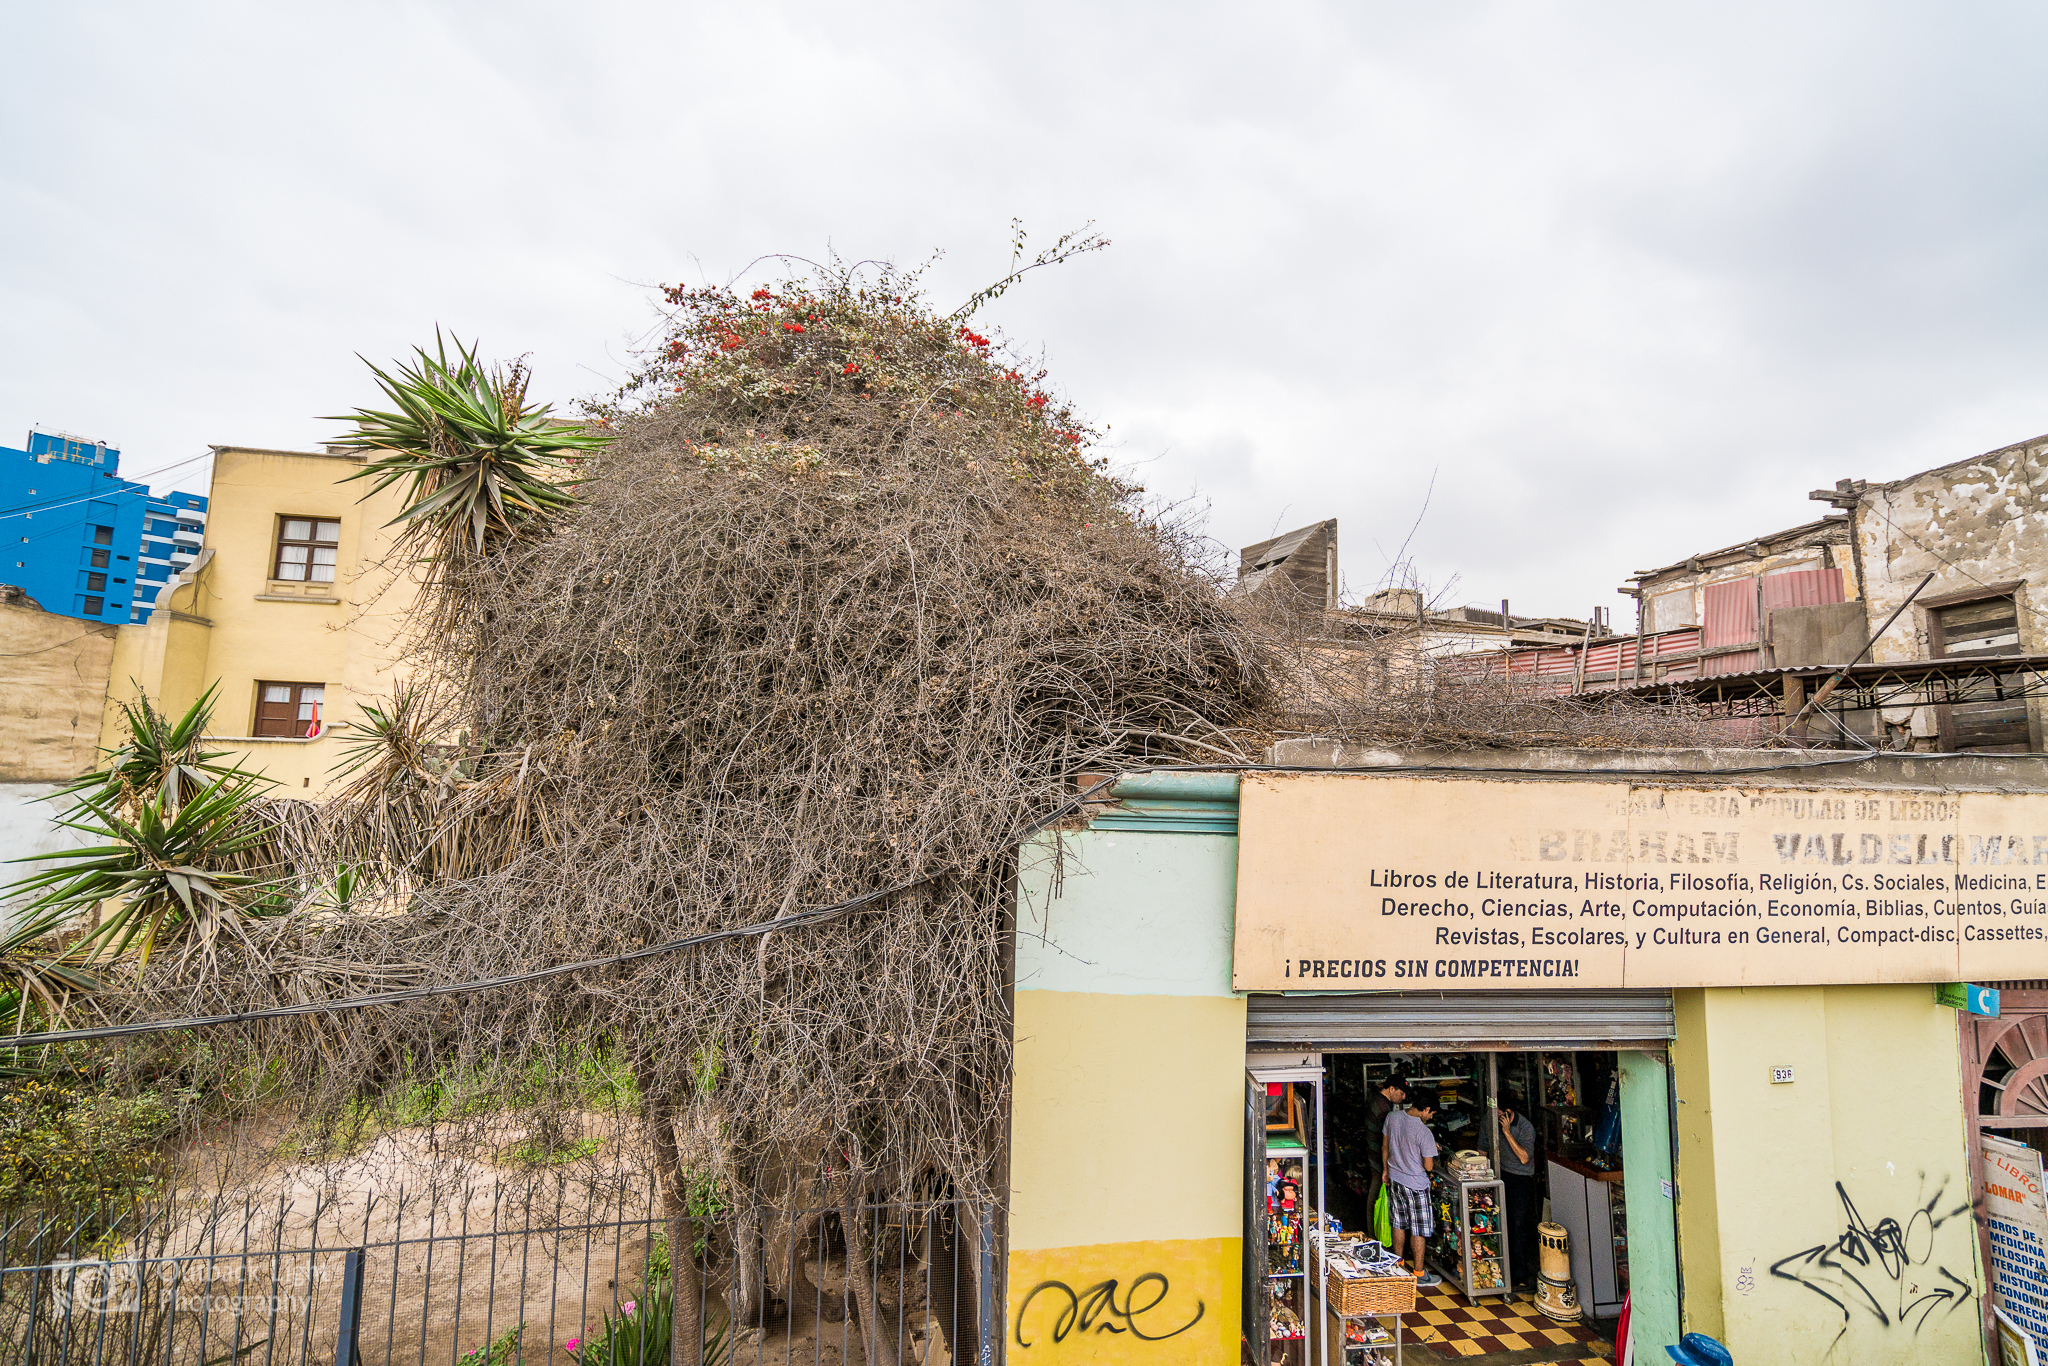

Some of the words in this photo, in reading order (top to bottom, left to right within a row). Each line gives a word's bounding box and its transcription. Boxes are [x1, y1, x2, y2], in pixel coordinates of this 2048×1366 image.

[1854, 800, 1880, 821] DE
[1508, 828, 1740, 863] BRAHAM
[1370, 869, 1437, 888] Libros
[1445, 870, 1469, 888] de
[1476, 871, 1578, 893] Literatura,
[1585, 872, 1664, 894] Historia,
[1670, 873, 1754, 894] Filosofía,
[1759, 872, 1837, 894] Religión,
[1842, 873, 1869, 891] Cs.
[1874, 873, 1950, 895] Sociales,
[1954, 874, 2033, 893] Medicina,
[2036, 874, 2048, 890] E
[1381, 897, 1474, 920] Derecho,
[1481, 898, 1573, 920] Ciencias,
[1579, 899, 1626, 921] Arte,
[1632, 899, 1762, 922] Computación,
[1768, 898, 1861, 919] Economía,
[1866, 899, 1929, 919] Biblias,
[1933, 899, 2007, 917] Cuentos,
[2010, 898, 2048, 915] Guía
[1435, 926, 1525, 949] Revistas,
[1531, 927, 1630, 949] Escolares,
[1636, 932, 1647, 950] y
[1653, 927, 1721, 945] Cultura
[1728, 931, 1750, 944] en
[1756, 926, 1831, 946] General,
[1837, 925, 1960, 946] Compact-disc,
[1964, 924, 2048, 942] Cassettes,
[1298, 959, 1387, 978] PRECIOS
[1394, 959, 1429, 978] SIN
[1435, 959, 1580, 978] COMPETENCIA!
[1987, 1217, 2019, 1237] IBROS
[2022, 1229, 2036, 1243] DE
[1990, 1230, 2046, 1259] MEDICINA
[1991, 1244, 2048, 1272] FILOSOFIA
[1991, 1256, 2048, 1286] ITERATURA
[2000, 1271, 2048, 1297] HISTORIA
[2004, 1298, 2048, 1323] DERECH
